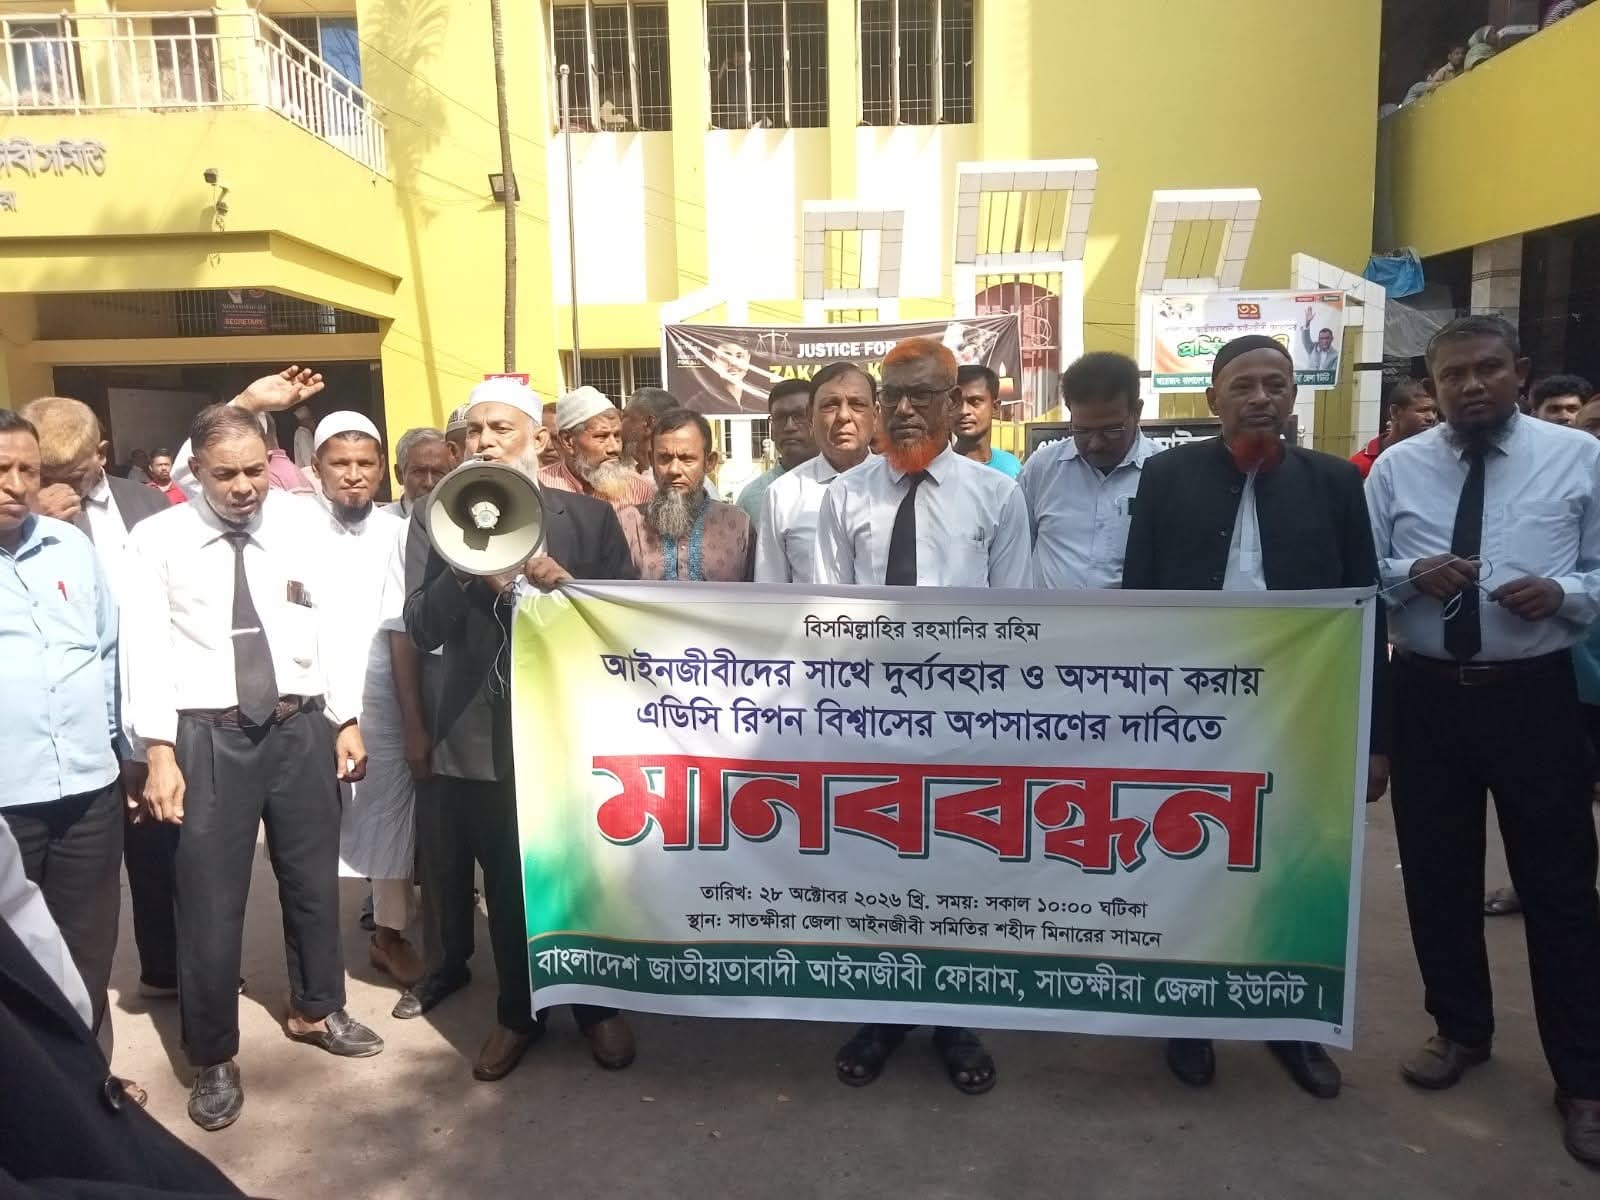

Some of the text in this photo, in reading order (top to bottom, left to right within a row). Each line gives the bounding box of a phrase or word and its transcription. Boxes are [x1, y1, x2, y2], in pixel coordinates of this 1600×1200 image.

[797, 342, 861, 359] JUSTICE
[804, 614, 1041, 643] বিসমিল্লাহির রহমানির রহিম
[600, 648, 1265, 698] আইনজীবীদের সাথে দুর্ব্যবহার ও অসম্মান করায়
[637, 695, 1227, 744] এডিসি রিপন বিশ্বাসের অপসারণের দাবিতে
[592, 755, 1274, 875] মানববন্ধন
[700, 881, 752, 902] তারিখ:
[760, 887, 783, 903] ২৮
[789, 885, 848, 905] অক্টোবর
[936, 894, 978, 912] সময়:
[985, 896, 1031, 913] সকাল
[1038, 898, 1092, 915] ১০:০০
[1099, 897, 1148, 919] ঘটিকা
[686, 908, 1163, 948] স্থান: সাতক্ষীরা জেলা আইনজীবী সমিতির শহীদ মিনারের সামনে
[535, 946, 640, 982] বাংলাদেশ
[646, 948, 801, 987] জাতীয়তাবাদী
[805, 951, 927, 992] আইনজীবী
[934, 962, 1025, 1002] ফোরাম,
[1033, 963, 1145, 1004] সাতক্ষীরা
[1154, 971, 1219, 1008] জেলা
[1225, 970, 1309, 1011] ইউনিট
